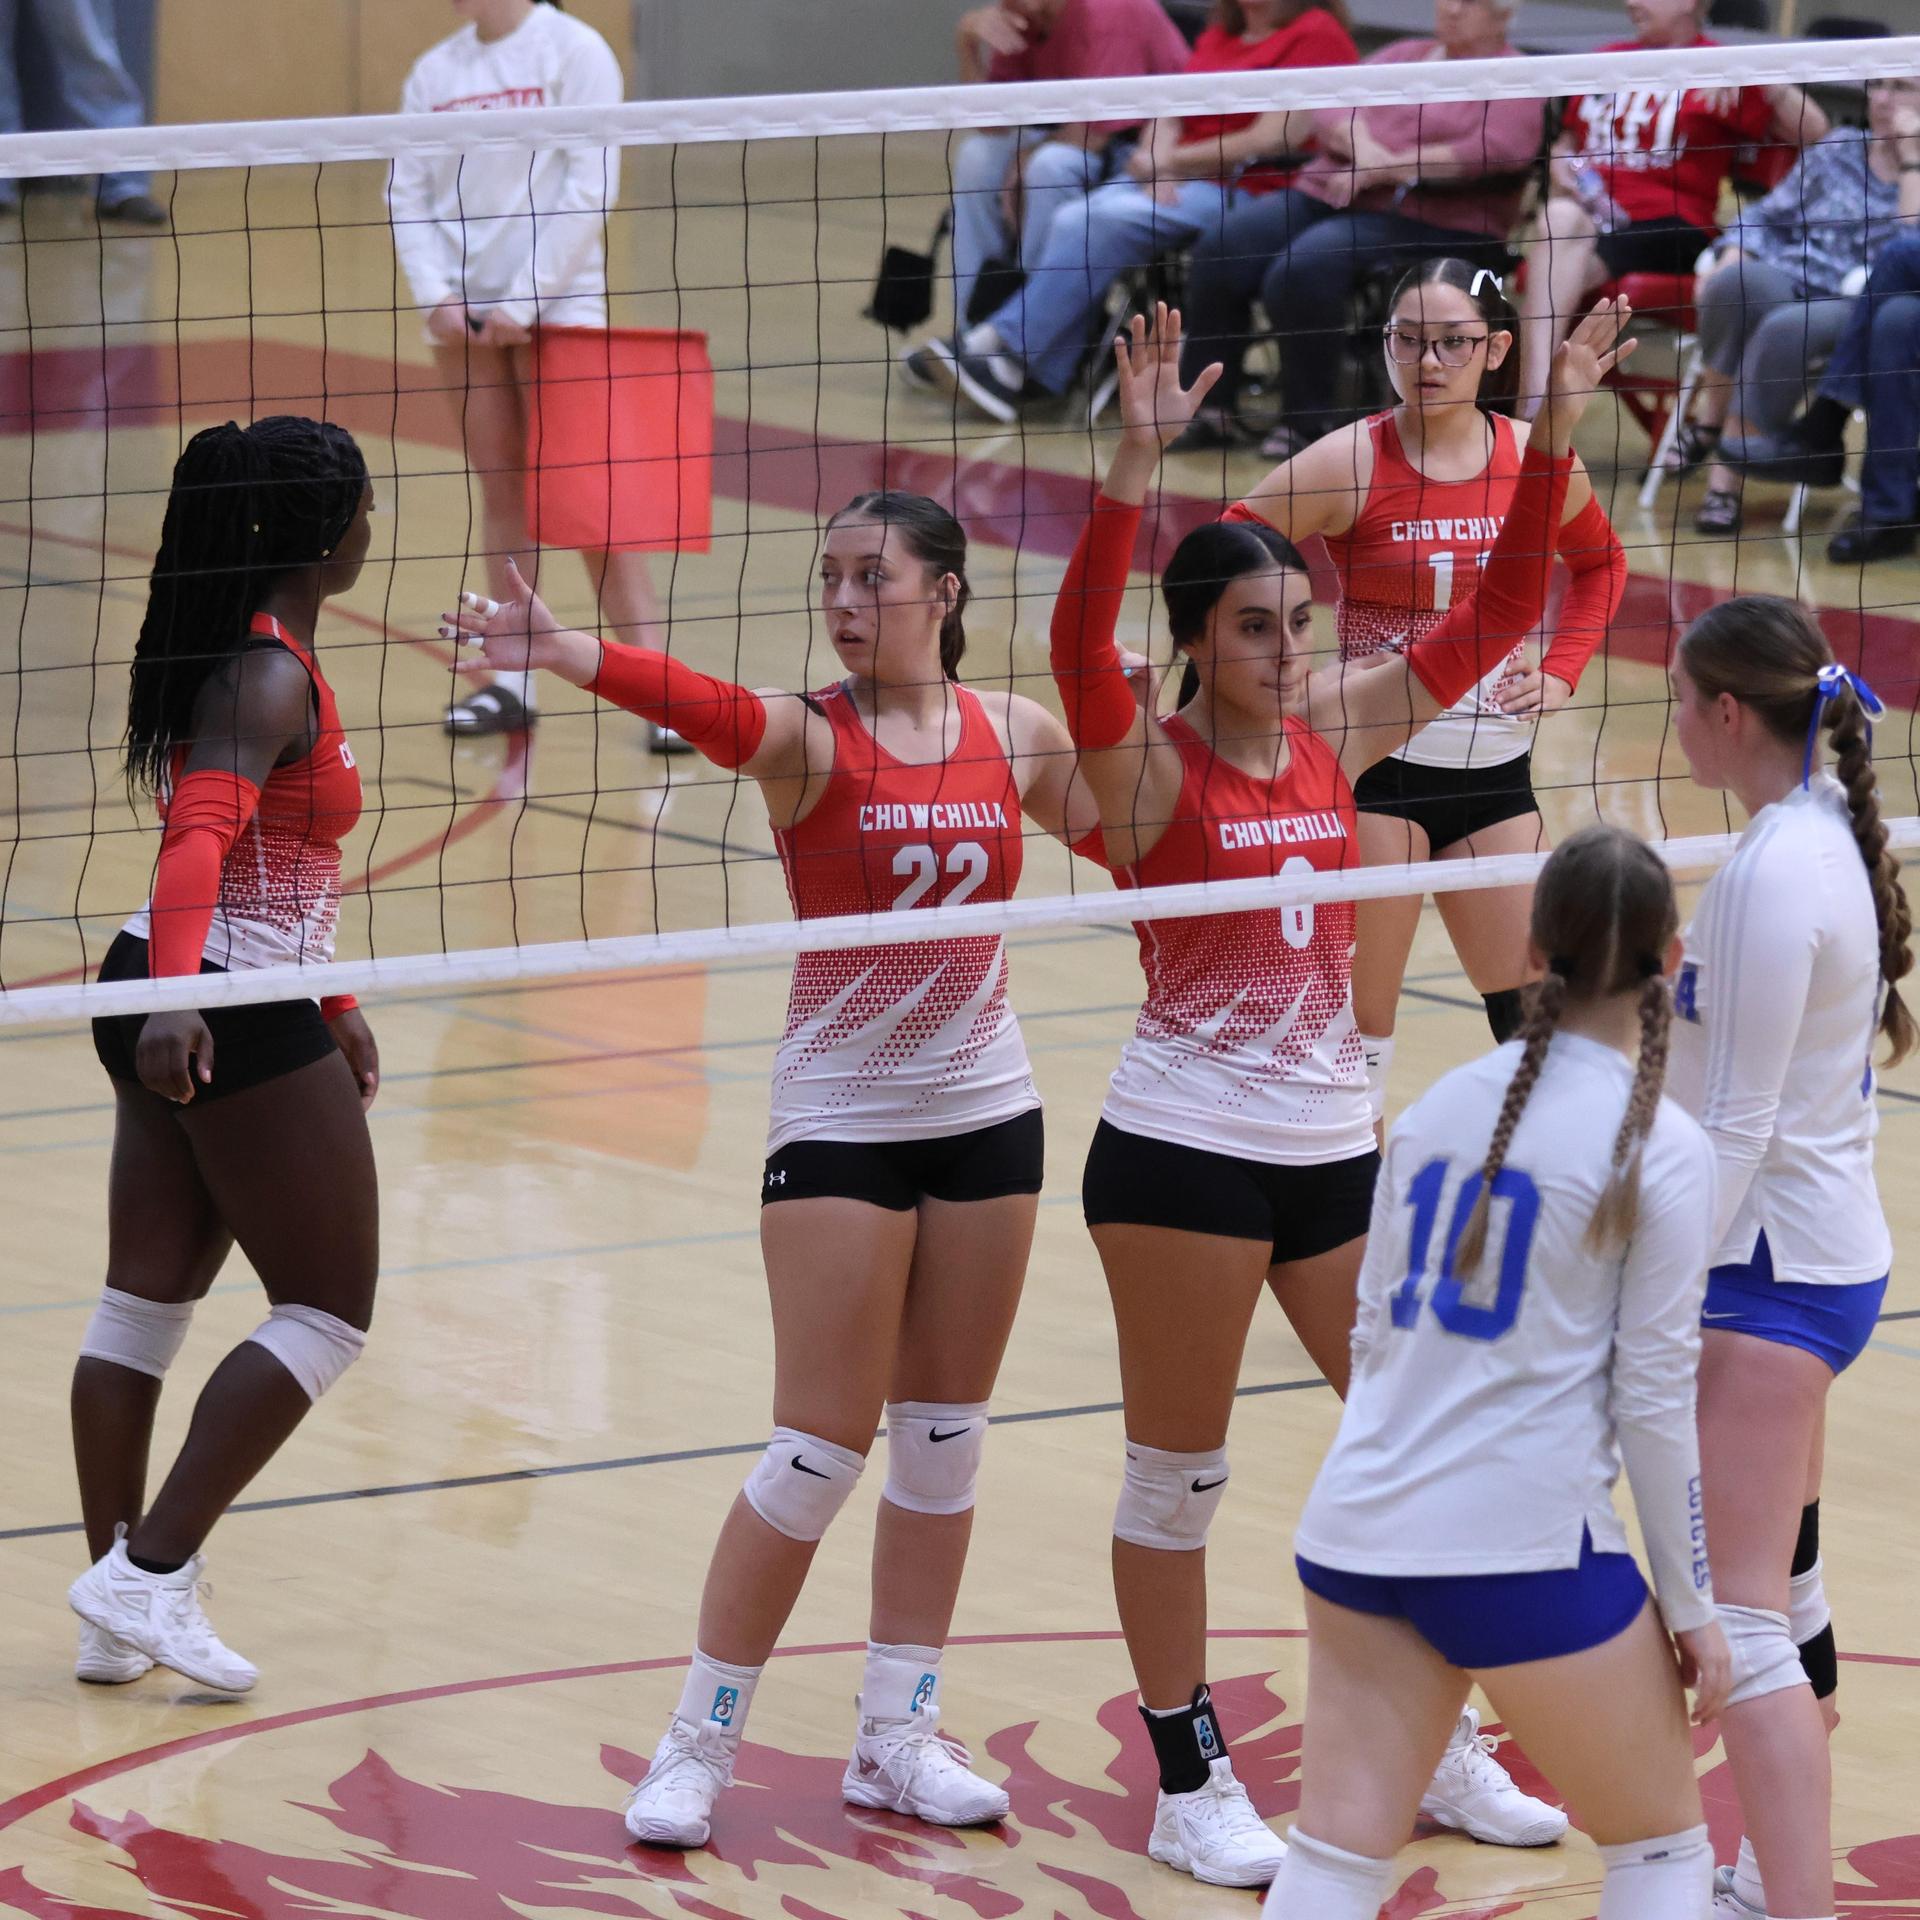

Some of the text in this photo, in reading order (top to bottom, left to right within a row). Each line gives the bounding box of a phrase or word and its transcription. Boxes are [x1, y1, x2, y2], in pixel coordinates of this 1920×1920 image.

[1391, 516, 1504, 542] CHOWCHIL
[860, 802, 1008, 831] CHOWCHILLA
[1219, 812, 1347, 850] CHOWCHILLA
[892, 842, 988, 911] 22
[1390, 1159, 1542, 1341] 10
